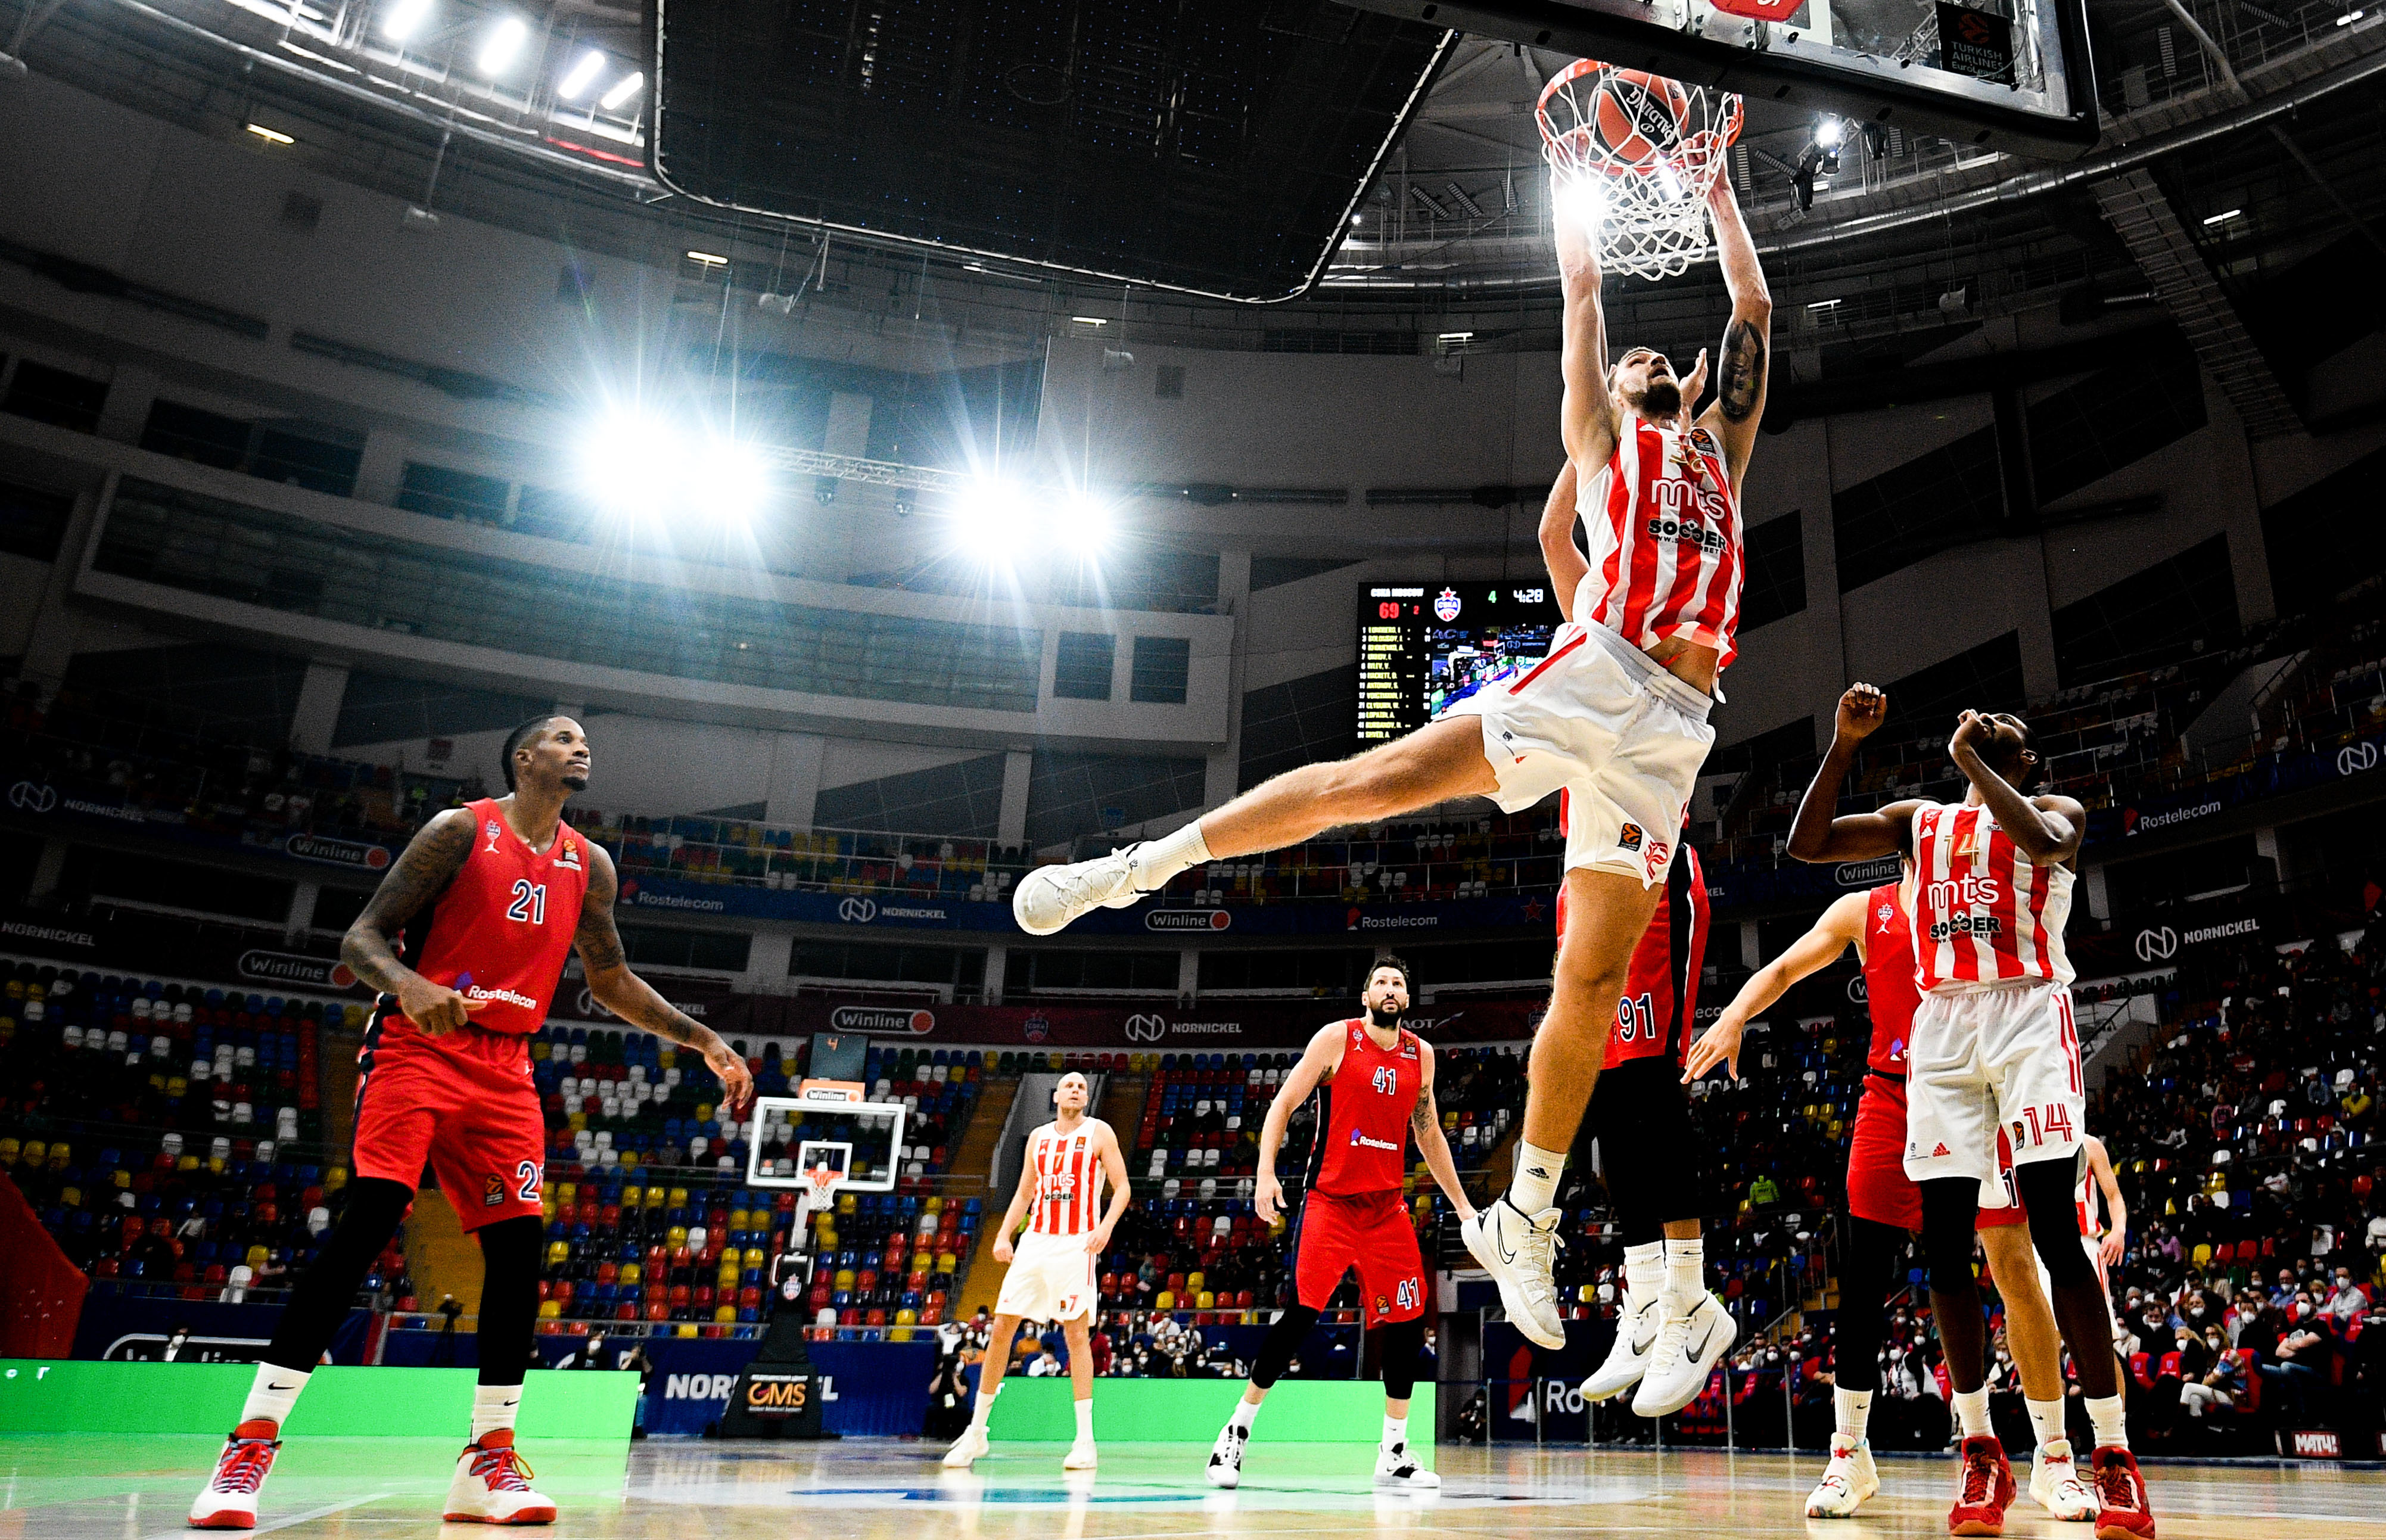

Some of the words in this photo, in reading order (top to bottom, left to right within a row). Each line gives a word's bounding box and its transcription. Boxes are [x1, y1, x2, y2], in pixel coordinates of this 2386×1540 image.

[1951, 41, 2002, 61] TURKISH
[1952, 51, 2004, 70] AIRLINES
[1651, 479, 1725, 519] mts
[1488, 590, 1497, 603] 4
[1513, 589, 1544, 603] 4:28
[1379, 602, 1400, 619] 69
[2140, 800, 2222, 830] Rostelecom
[298, 839, 360, 861] Winline
[1944, 833, 1980, 868] 14
[1842, 861, 1896, 881] Winline
[506, 878, 547, 925] 21
[638, 891, 724, 912] Rostelecom
[1927, 872, 1999, 910] mts
[881, 907, 947, 920] NORNICKEL
[1153, 914, 1206, 928] Winline
[1361, 914, 1438, 928] Rostelecom
[0, 920, 96, 947] NORNICKEL
[1930, 916, 2001, 938] SOCCER
[2183, 917, 2260, 944] NORNICKEL
[249, 956, 324, 981] Winline
[839, 1012, 905, 1029] Winline
[1172, 1022, 1242, 1034] NORNICKEL
[1617, 992, 1656, 1042] 91
[1372, 1066, 1396, 1095] 41
[808, 1090, 845, 1101] Winline
[2023, 1103, 2073, 1146] 14
[1069, 1294, 1079, 1312] 7
[1396, 1277, 1420, 1311] 41
